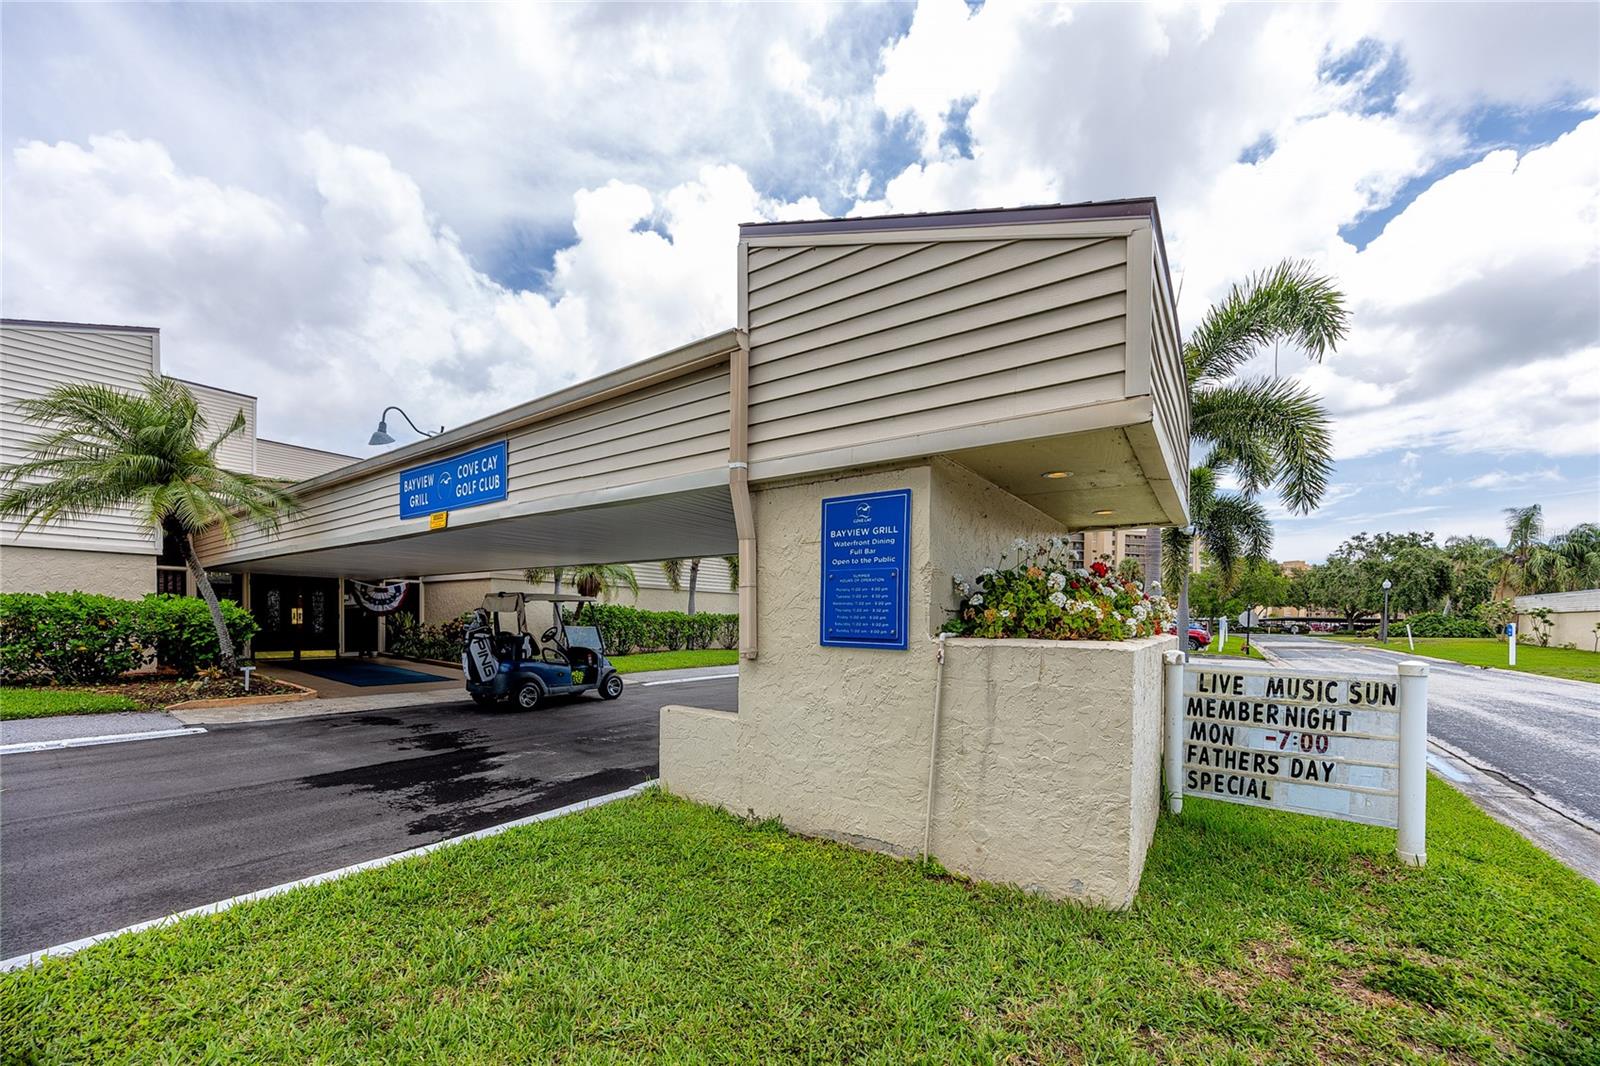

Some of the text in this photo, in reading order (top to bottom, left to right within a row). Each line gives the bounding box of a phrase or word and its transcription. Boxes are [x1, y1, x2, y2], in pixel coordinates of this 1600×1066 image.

[458, 454, 498, 479] COVE CAY
[404, 474, 434, 492] BAYVIEW
[456, 474, 500, 497] GOLF CLUB
[410, 492, 428, 508] GRILL
[830, 526, 898, 538] BAYVIEW GRILL
[474, 638, 495, 677] PING
[1199, 673, 1396, 706] LIVE MUSIC SUN
[1190, 721, 1234, 746] MON
[1187, 744, 1335, 782] FATHERS DAY
[1187, 770, 1271, 801] SPECIAL
